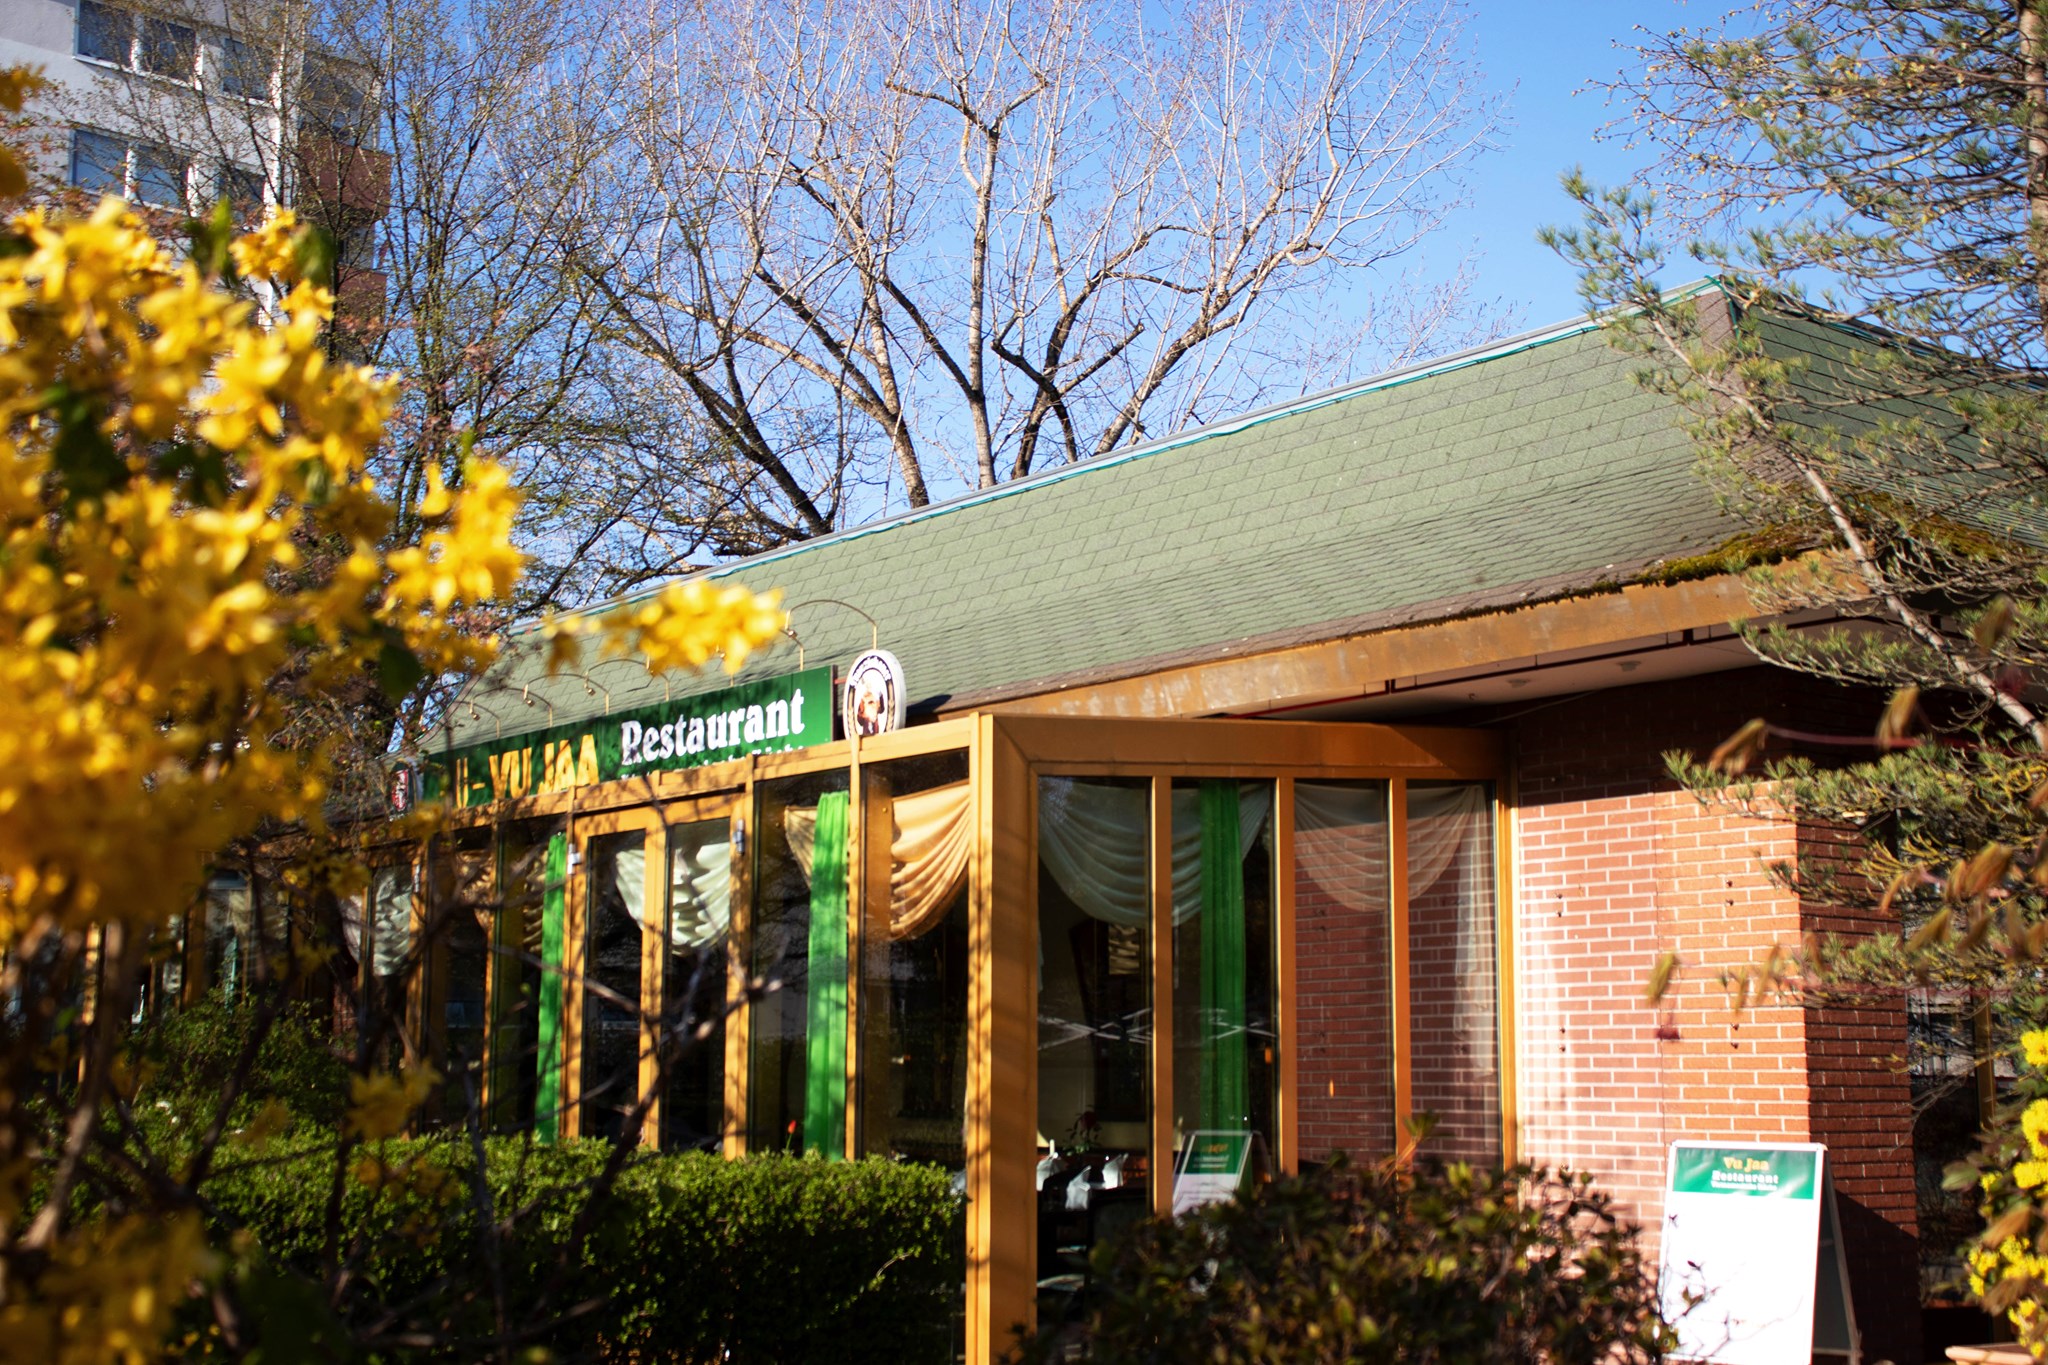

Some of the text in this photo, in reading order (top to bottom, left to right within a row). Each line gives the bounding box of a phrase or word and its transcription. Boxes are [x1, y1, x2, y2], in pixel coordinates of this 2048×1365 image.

[621, 688, 805, 766] Restaurant
[1723, 1157, 1743, 1170] Vu
[1712, 1170, 1779, 1184] Restaurant
